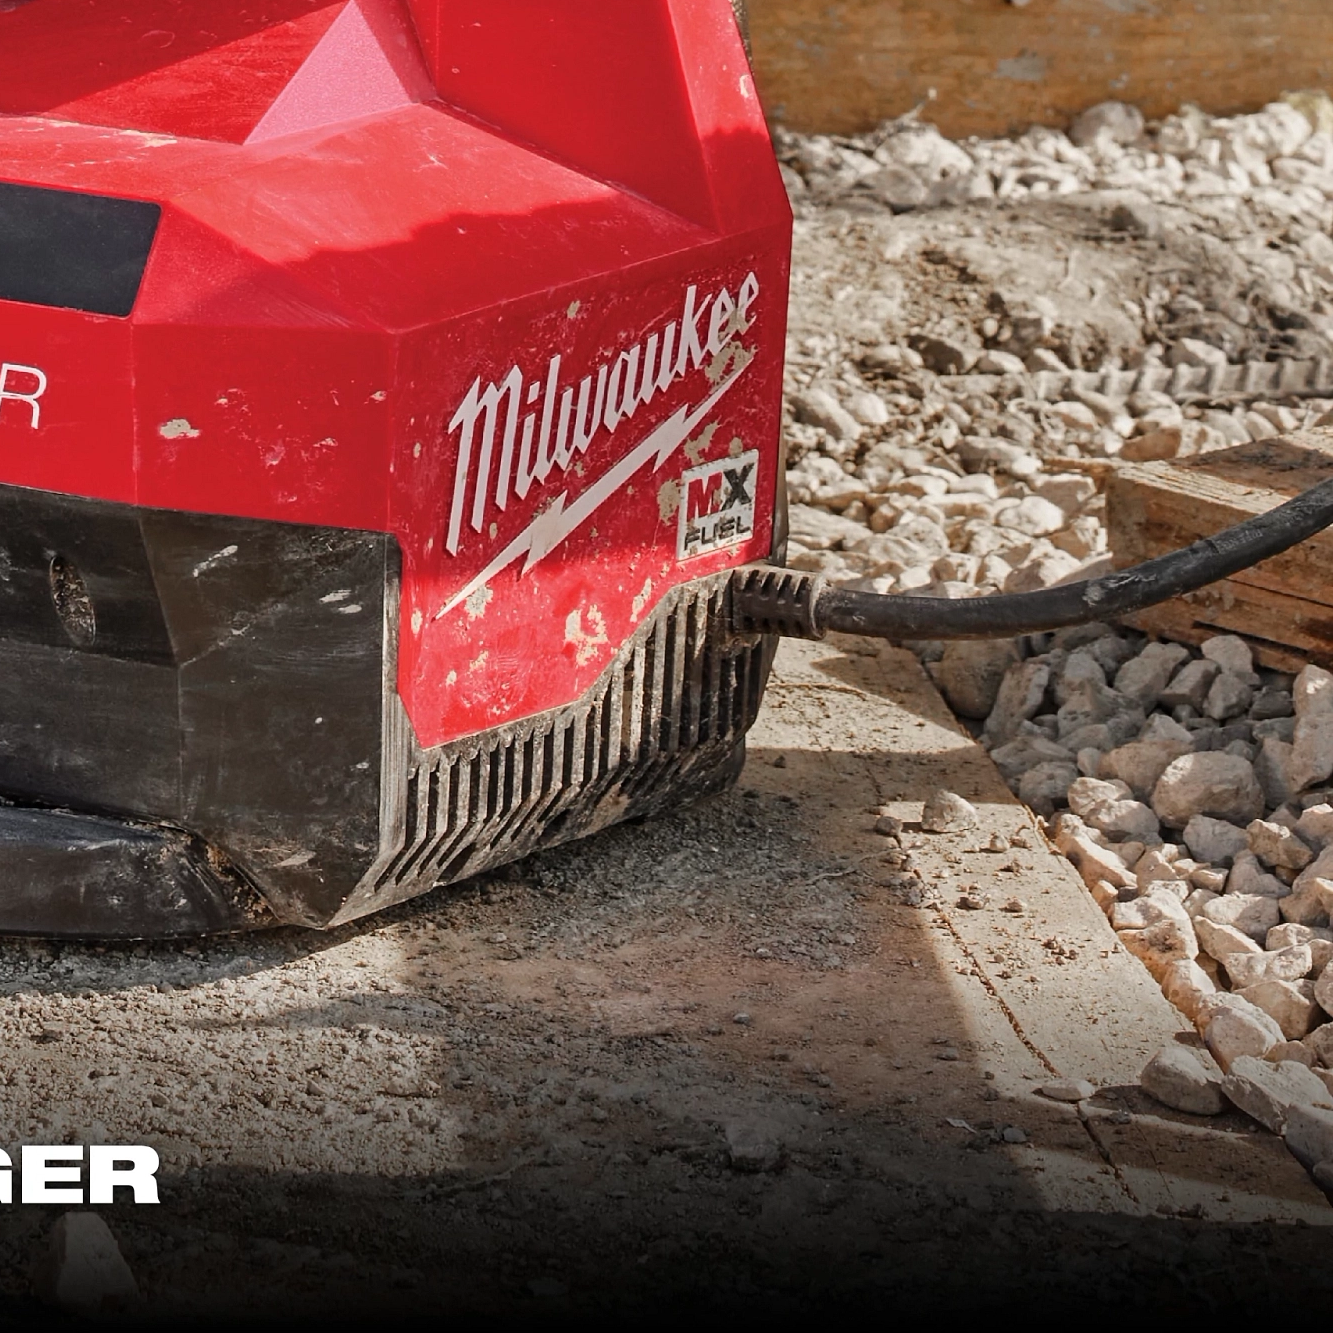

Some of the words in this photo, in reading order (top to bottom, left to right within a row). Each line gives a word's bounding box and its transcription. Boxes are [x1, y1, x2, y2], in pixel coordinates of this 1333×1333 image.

[446, 271, 760, 558] Milwaukee
[686, 463, 755, 519] MX
[683, 515, 751, 551] FUEL
